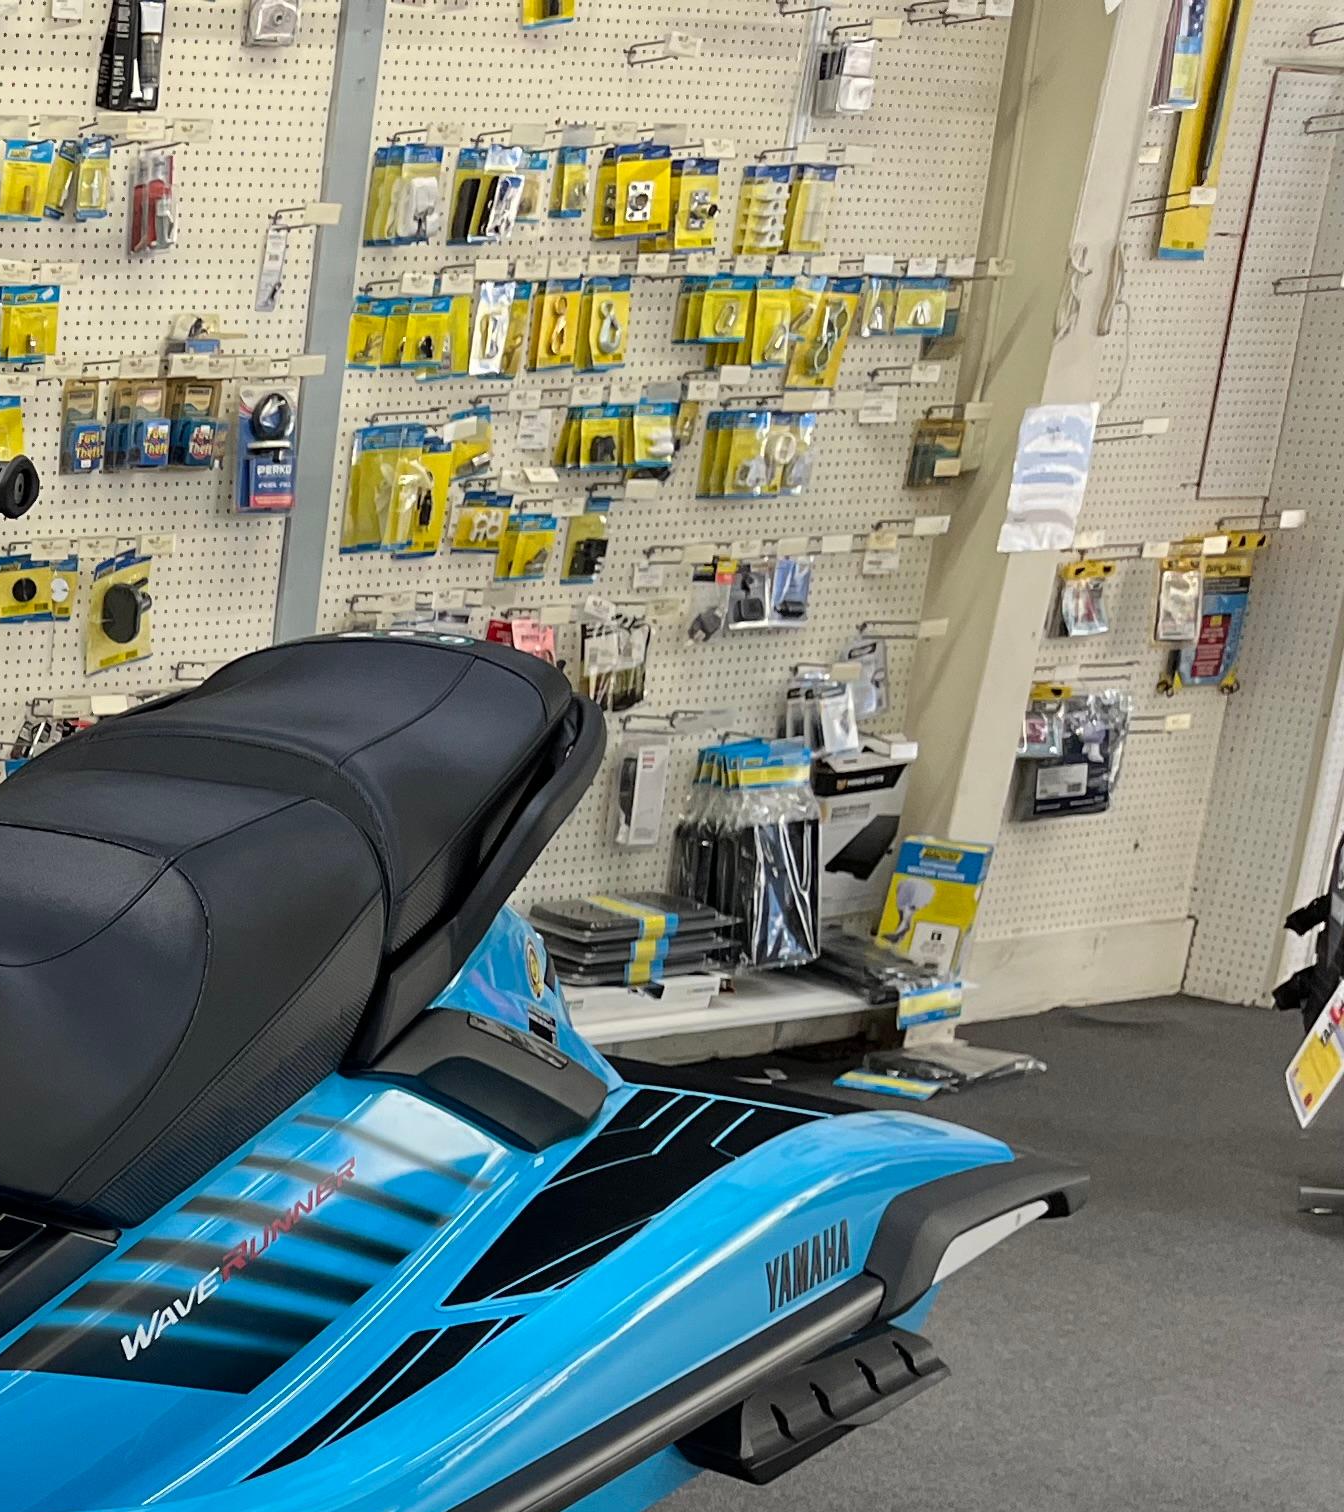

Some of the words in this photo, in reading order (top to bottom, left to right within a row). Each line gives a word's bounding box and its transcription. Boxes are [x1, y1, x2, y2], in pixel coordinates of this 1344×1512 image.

[257, 464, 292, 475] PERKO
[120, 1156, 357, 1361] WAVERUNNER
[765, 1218, 850, 1313] YAMAHA
